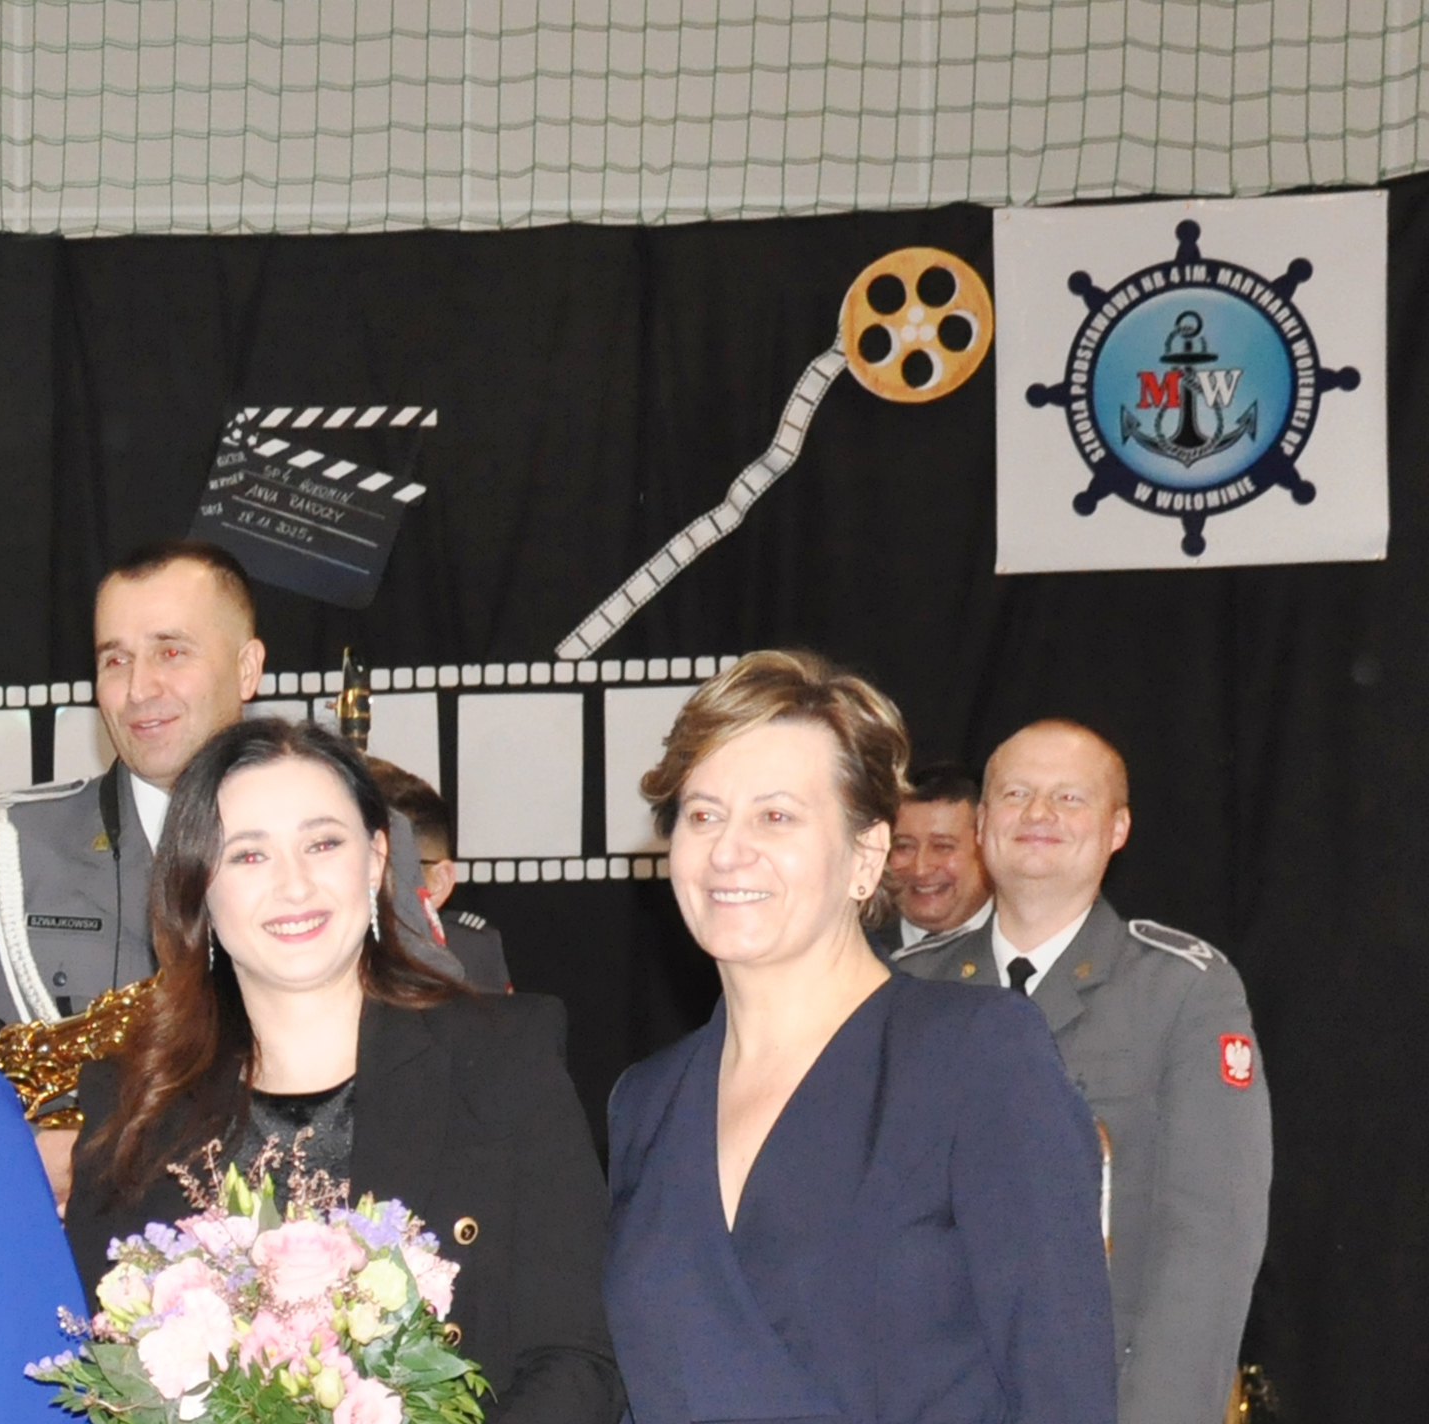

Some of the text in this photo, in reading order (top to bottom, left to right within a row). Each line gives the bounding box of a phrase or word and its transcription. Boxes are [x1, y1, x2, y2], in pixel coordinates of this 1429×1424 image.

[1142, 271, 1167, 293] NR
[1169, 266, 1181, 284] 4
[1216, 269, 1302, 340] MARYNARKI
[1070, 282, 1141, 396] PODSTAWOWA
[1290, 337, 1319, 430] WOJENNEJ
[1279, 430, 1302, 456] RP
[1133, 482, 1154, 503] W
